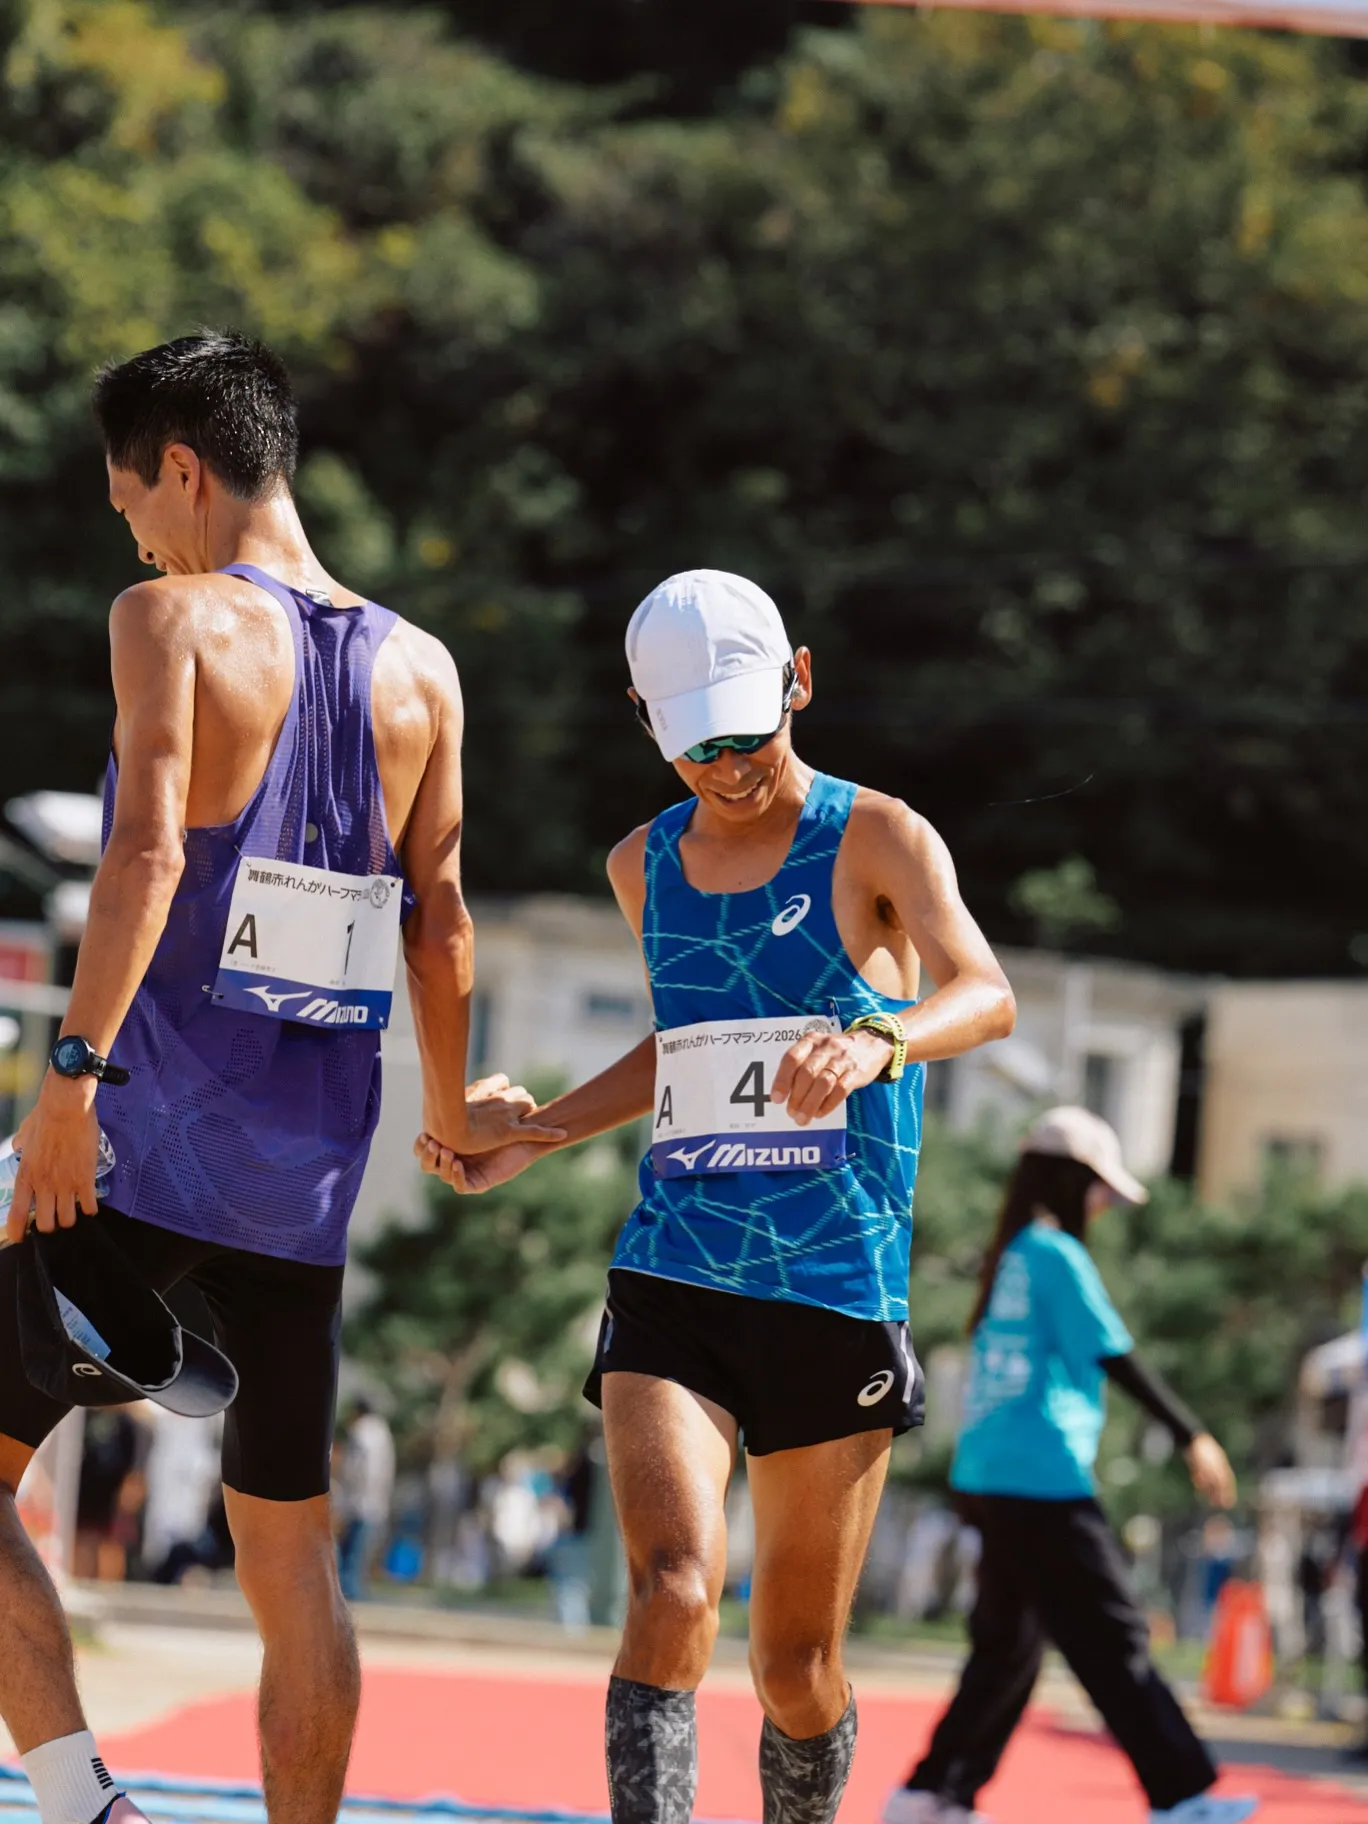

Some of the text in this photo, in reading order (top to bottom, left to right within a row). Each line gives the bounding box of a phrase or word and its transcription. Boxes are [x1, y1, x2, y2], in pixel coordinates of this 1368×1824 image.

[227, 913, 356, 976] A 1
[656, 1085, 673, 1129] A
[730, 1060, 772, 1118] 4
